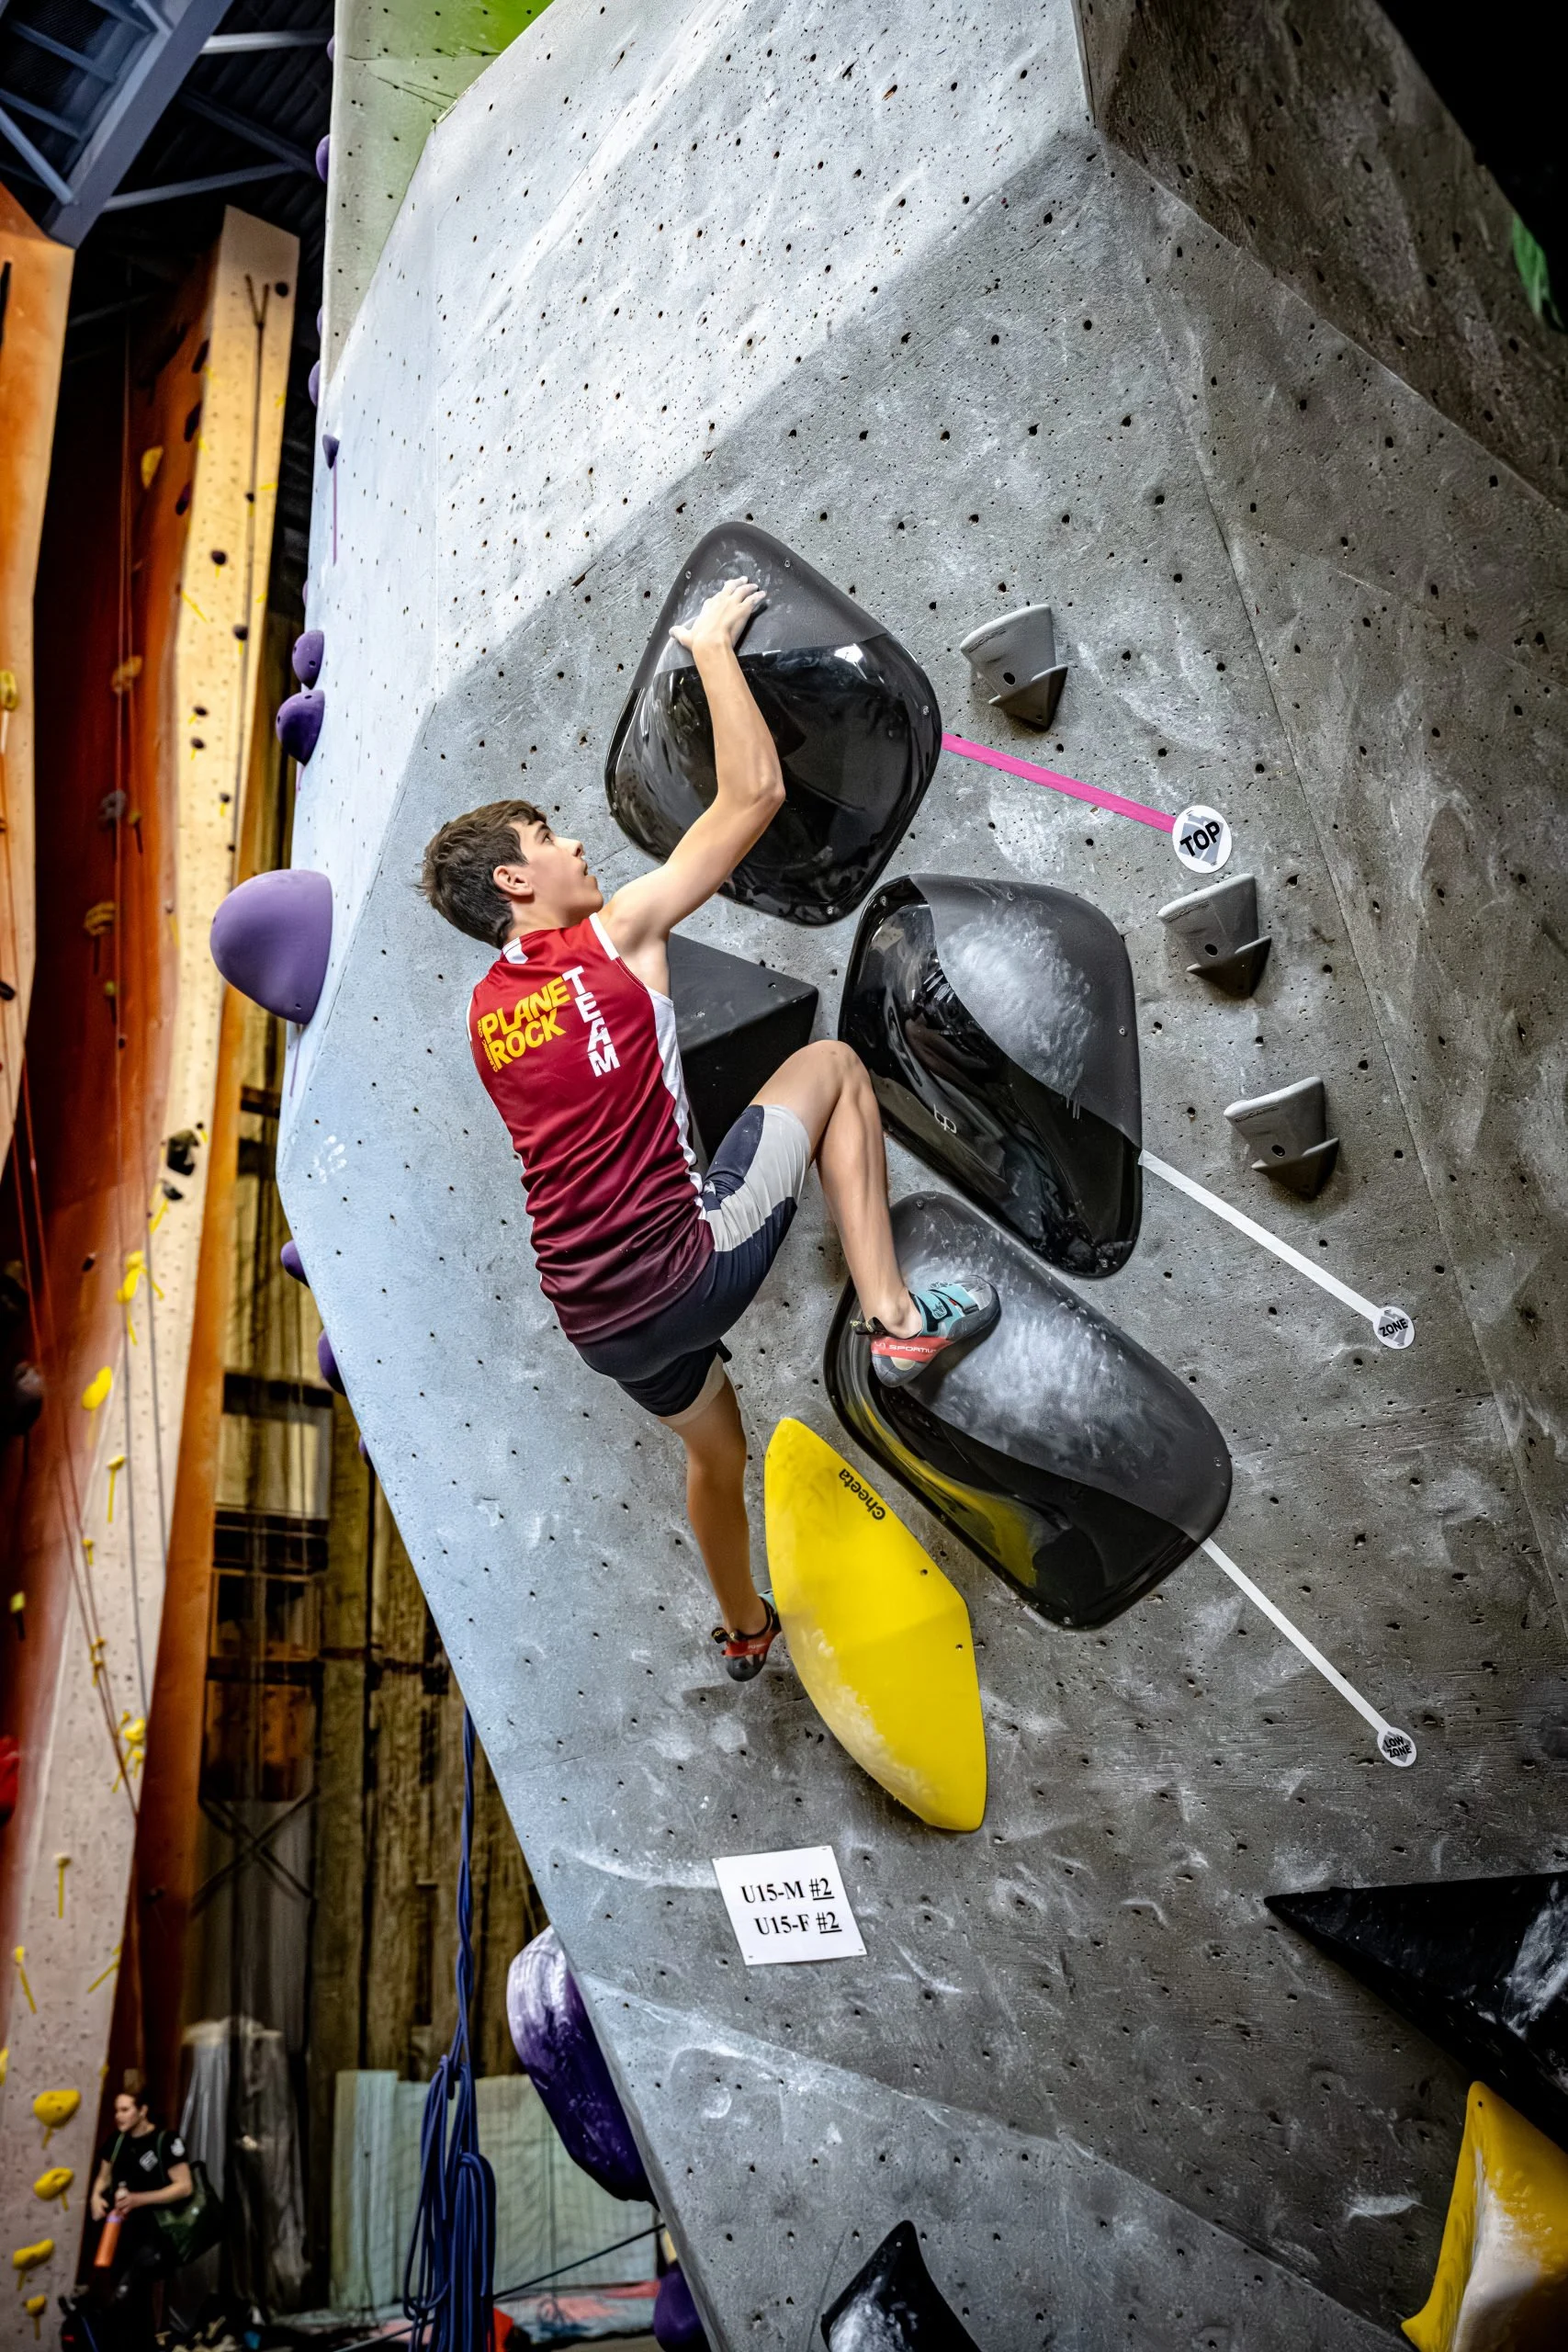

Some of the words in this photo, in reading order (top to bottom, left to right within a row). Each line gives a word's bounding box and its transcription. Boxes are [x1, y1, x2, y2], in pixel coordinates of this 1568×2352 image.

[1179, 820, 1220, 857] TOP
[562, 966, 620, 1077] TEAM
[489, 1007, 566, 1070] ROCK
[1379, 1318, 1408, 1337] ZONE
[839, 1468, 886, 1521] Cheeta
[1383, 1736, 1404, 1748] LOW
[1387, 1745, 1412, 1758] ZONE
[740, 1881, 806, 1904] U15-M
[808, 1877, 835, 1901] #2
[753, 1914, 810, 1936] U15-F
[816, 1911, 842, 1934] #2
